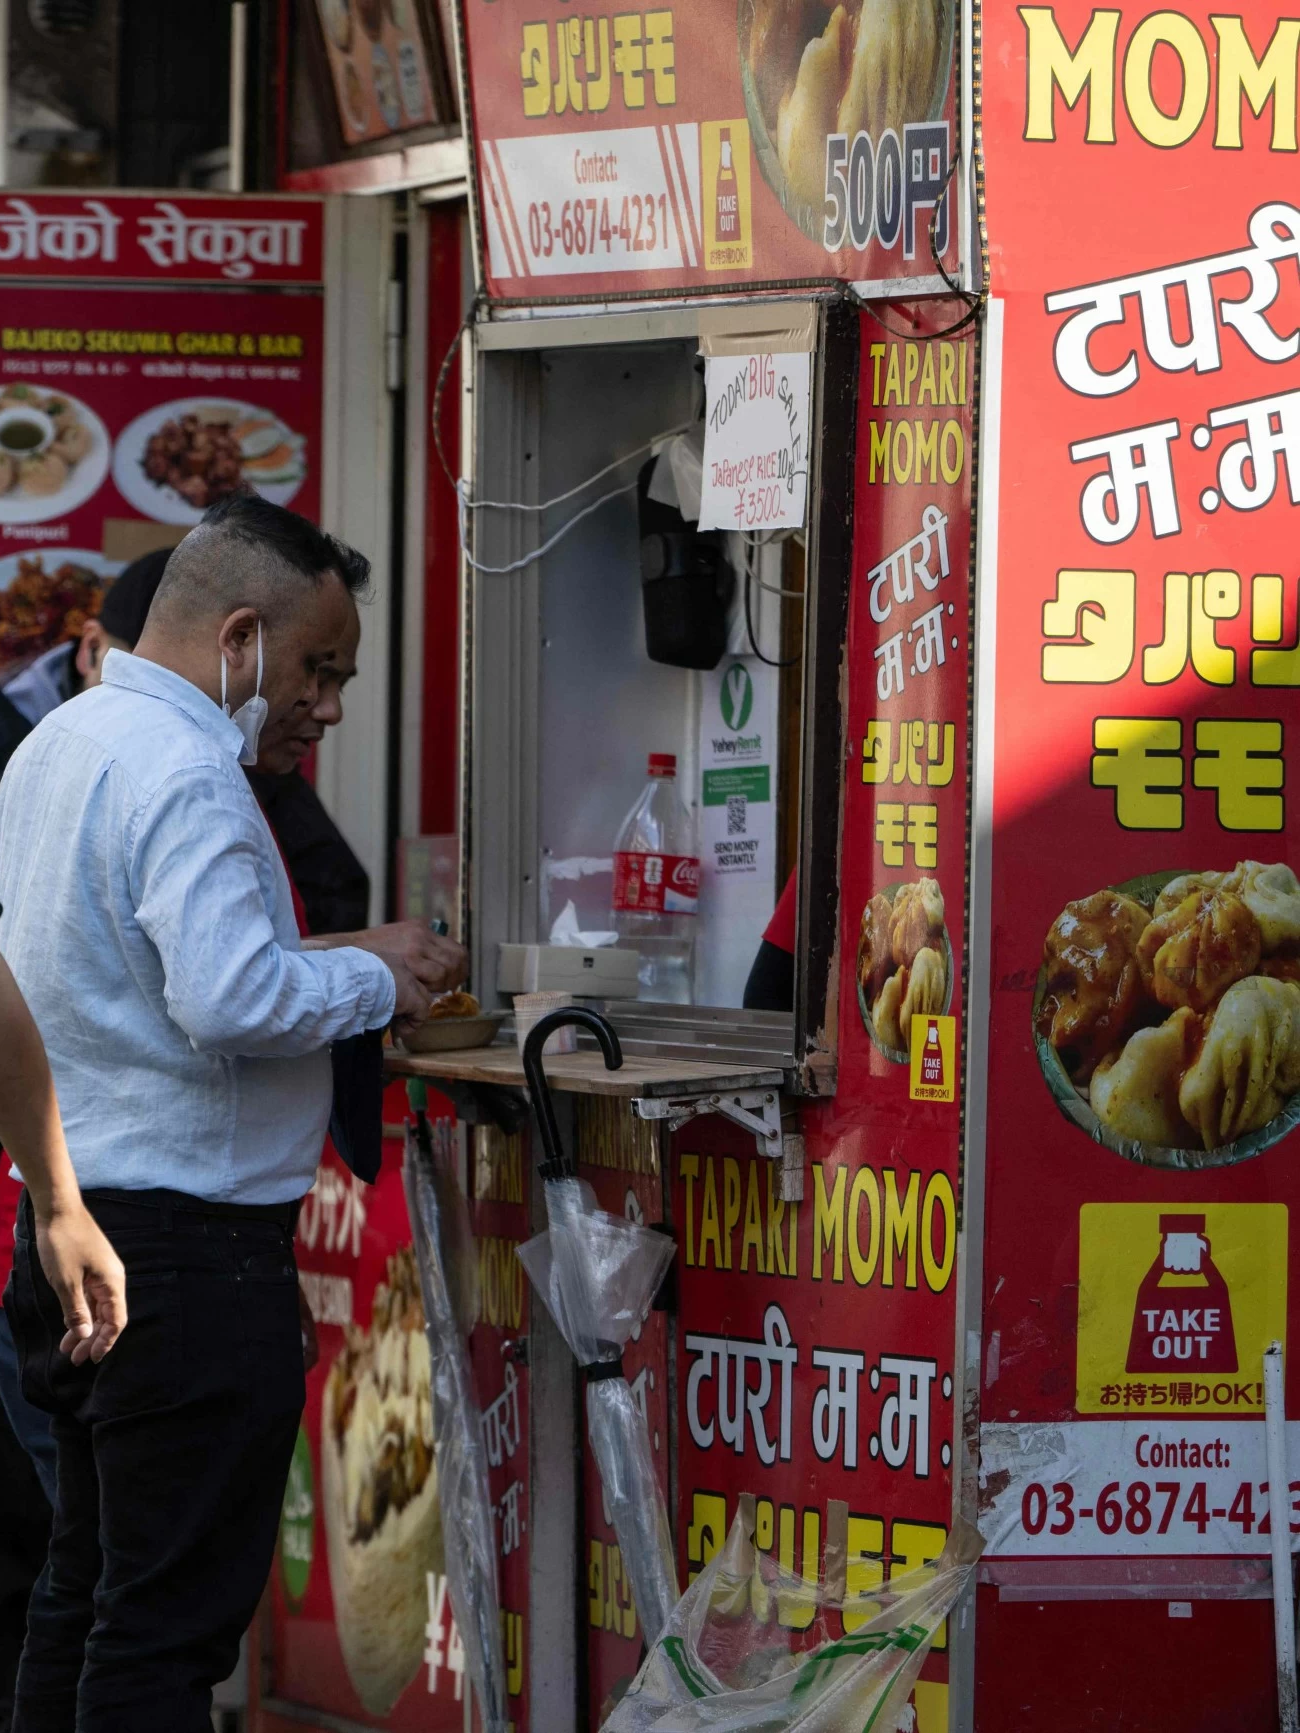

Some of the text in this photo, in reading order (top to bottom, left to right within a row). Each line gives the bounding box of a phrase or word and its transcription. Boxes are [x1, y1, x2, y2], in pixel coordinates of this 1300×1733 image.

[520, 8, 677, 119] タパリモモ
[574, 149, 618, 185] Contact:
[822, 120, 950, 261] 500円
[528, 193, 669, 257] 03-6874-4231
[717, 195, 737, 212] TAKE
[720, 215, 735, 231] OUT
[137, 202, 308, 279] सेकुवा
[2, 328, 303, 357] BAJEKO SEKUWA GHAR & BAR
[869, 340, 968, 407] TAPARI
[710, 366, 749, 433] TODAY
[748, 353, 775, 400] BIG
[757, 451, 777, 480] RICE
[868, 419, 966, 484] MOMO
[866, 504, 951, 624] टपरी
[861, 719, 956, 787] タパリ
[1089, 716, 1286, 833] モモ
[714, 840, 760, 855] SEND MONEY
[874, 803, 939, 868] モモ
[923, 1057, 941, 1069] TAKE
[925, 1069, 939, 1080] OUT
[680, 1154, 957, 1295] TAPARI MOMO
[1142, 1308, 1221, 1332] TAKE
[1152, 1335, 1212, 1360] OUT
[479, 1361, 521, 1468] परी
[685, 1301, 798, 1467] टपरी
[1100, 1381, 1264, 1407] お持ち帰りOK!
[1135, 1433, 1231, 1469] Contact:
